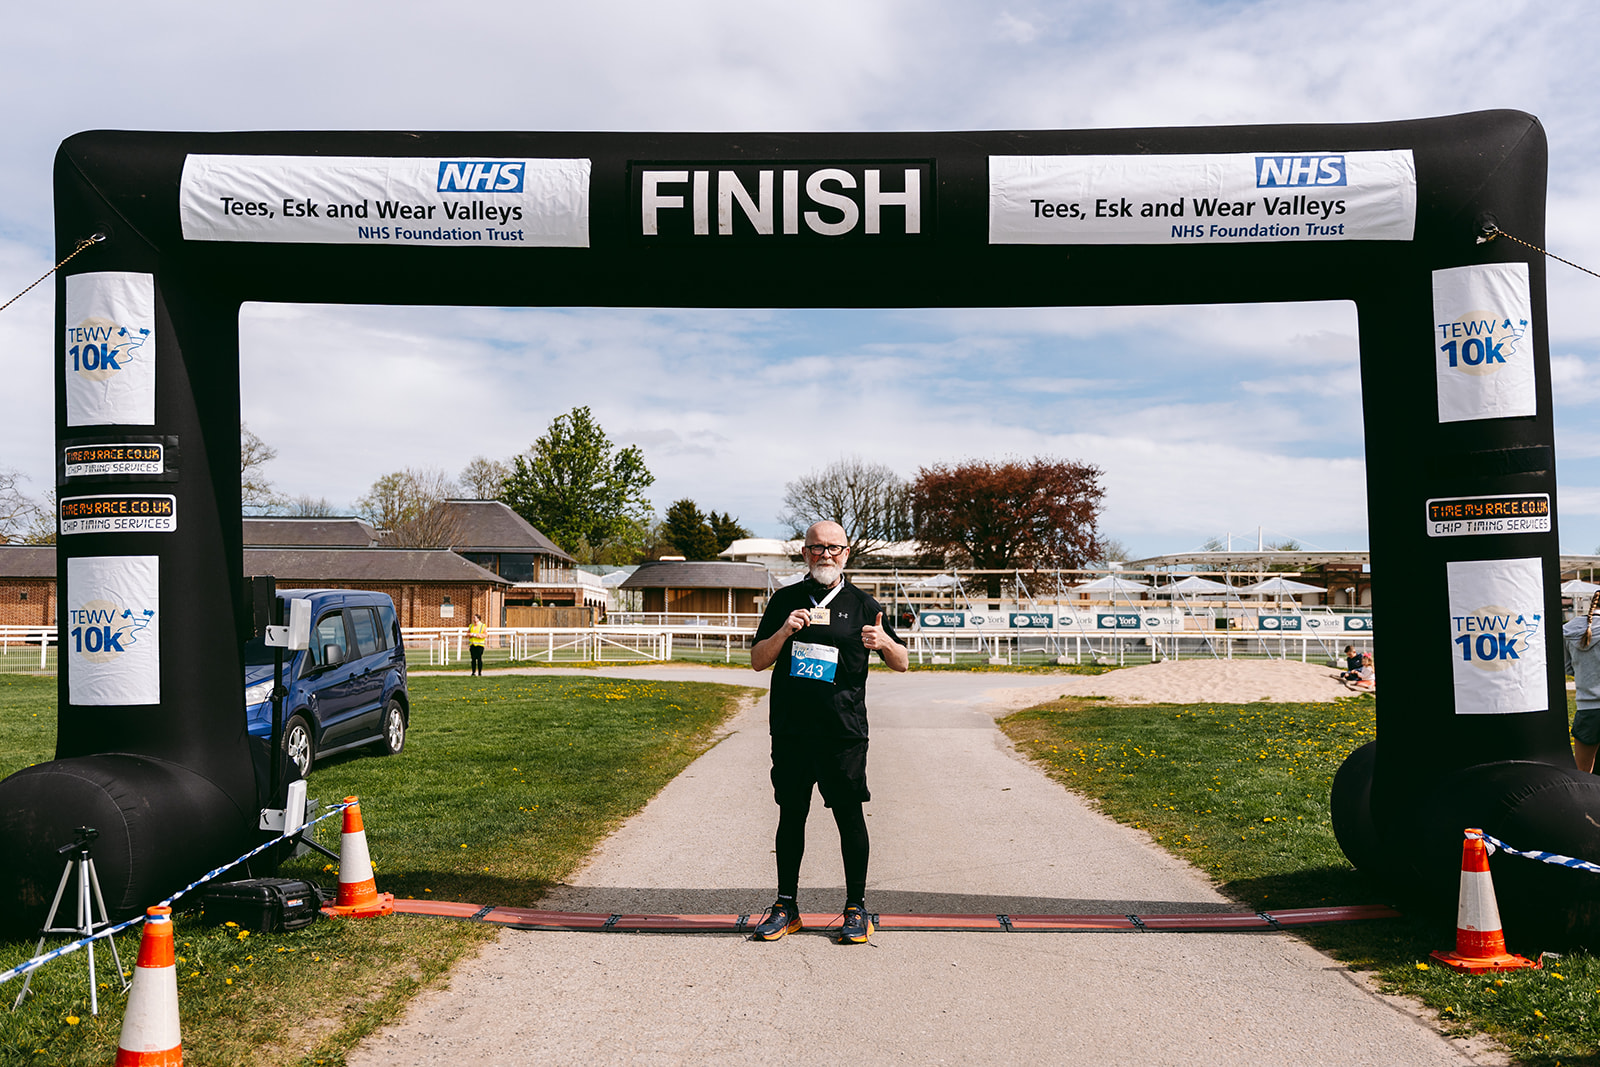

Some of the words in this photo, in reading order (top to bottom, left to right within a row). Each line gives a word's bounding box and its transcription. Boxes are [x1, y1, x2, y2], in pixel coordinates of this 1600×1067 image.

[439, 163, 524, 191] NHS
[1259, 157, 1345, 185] NHS
[642, 168, 920, 236] FINISH
[1030, 199, 1085, 220] Tees,
[1095, 199, 1133, 217] Esk
[1141, 198, 1185, 217] and
[1193, 198, 1256, 217] Wear
[1263, 196, 1346, 219] Valleys
[220, 197, 275, 218] Tees,
[282, 199, 319, 218] Esk
[326, 200, 368, 219] and
[375, 201, 437, 220] Wear
[443, 201, 523, 225] Valleys
[358, 226, 390, 239] NHS
[395, 227, 482, 241] Foundation
[486, 228, 524, 241] Trust
[1171, 225, 1205, 238] NHS
[1209, 224, 1300, 238] Foundation
[1304, 223, 1345, 236] Trust
[68, 327, 112, 342] TEWV
[1438, 319, 1496, 338] TEWV
[69, 343, 121, 371] 10k
[1440, 337, 1506, 367] 10k
[85, 464, 110, 473] TIMING
[113, 463, 159, 472] SERVICES
[63, 521, 78, 533] CHIP
[81, 520, 111, 531] TIMING
[114, 519, 170, 529] SERVICES
[1435, 522, 1462, 534] CHIP
[1466, 520, 1503, 532] TIMING
[1507, 519, 1548, 530] SERVICES
[70, 609, 116, 624] TEWV
[987, 616, 1006, 624] York
[1118, 616, 1137, 625] York
[1452, 615, 1510, 631] TEWV
[71, 626, 125, 652] 10k
[1455, 632, 1520, 661] 10k
[797, 662, 823, 678] 243
